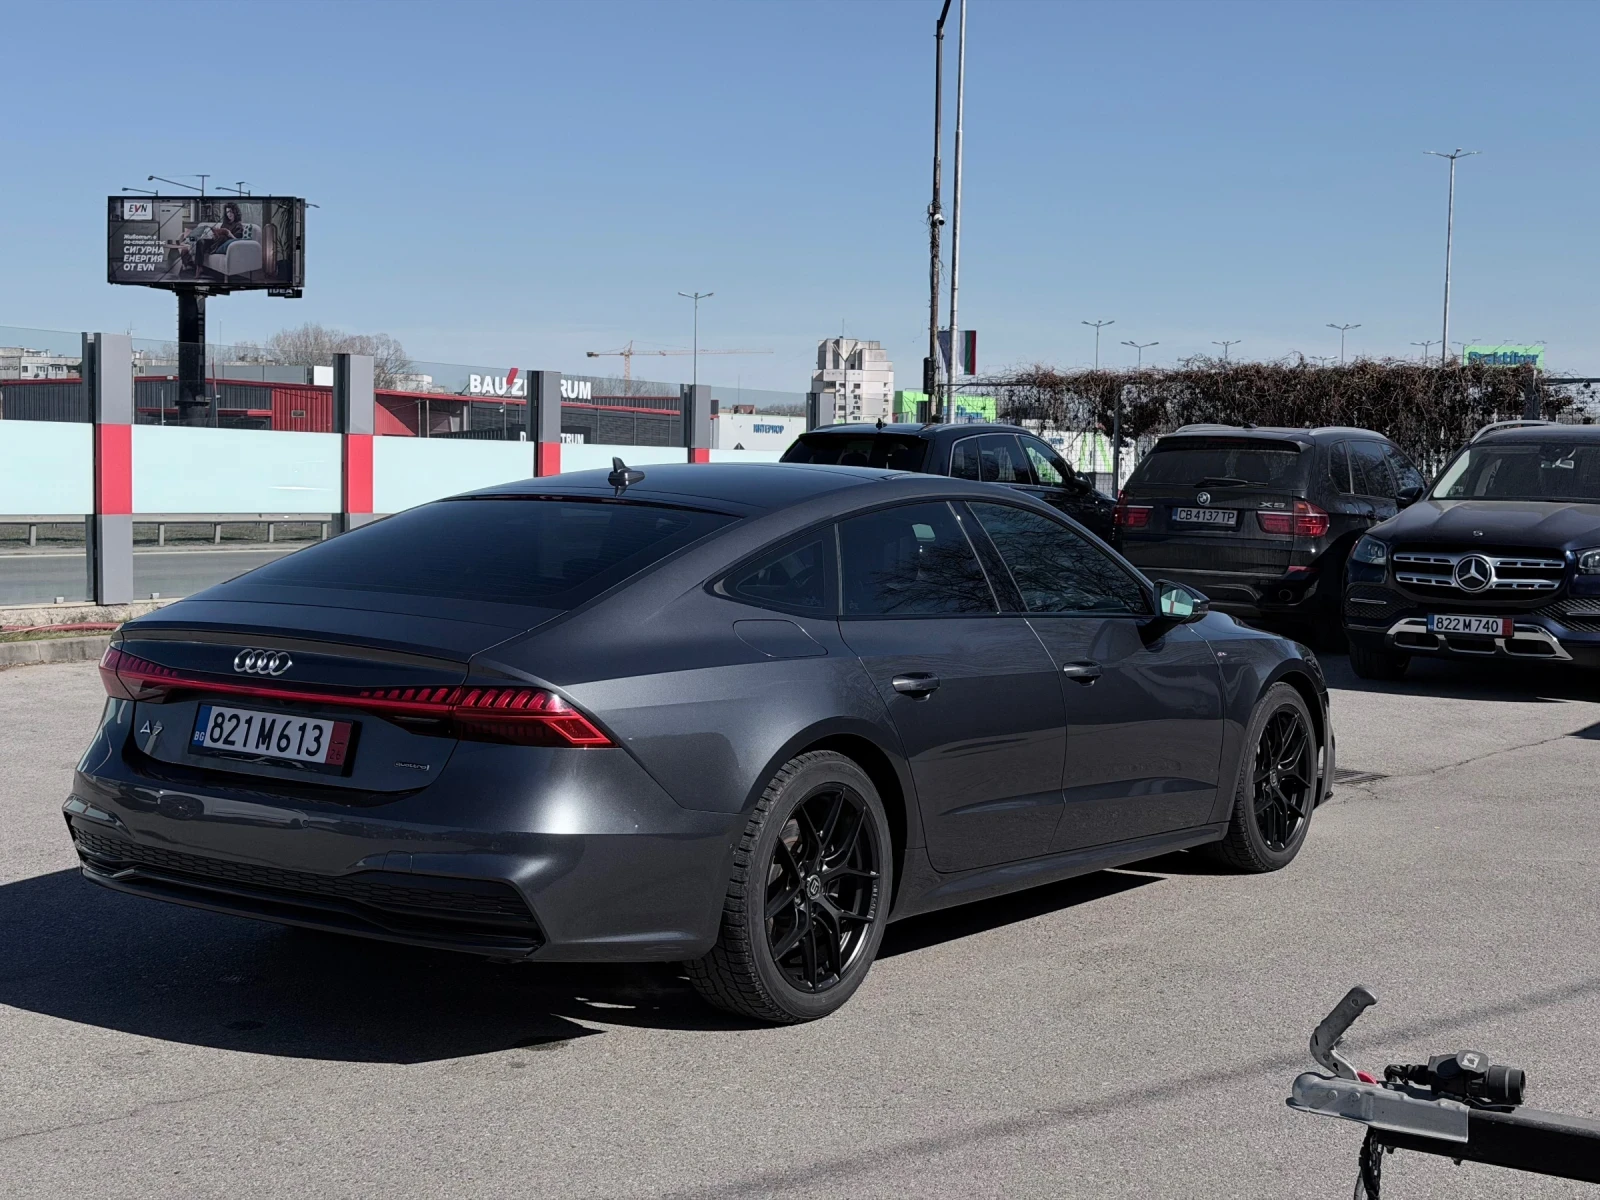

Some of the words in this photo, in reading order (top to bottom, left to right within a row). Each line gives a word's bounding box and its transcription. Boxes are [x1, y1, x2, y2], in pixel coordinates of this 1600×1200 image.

[128, 204, 147, 213] EVN
[123, 246, 164, 254] СИГУРНА
[123, 255, 163, 263] ЕНЕРГИЯ
[123, 263, 136, 271] ОТ
[1260, 501, 1286, 509] X5
[1178, 509, 1193, 521] CB
[1194, 511, 1219, 522] 4137
[1221, 511, 1235, 522] TP
[140, 720, 163, 736] A7
[193, 730, 205, 741] BG
